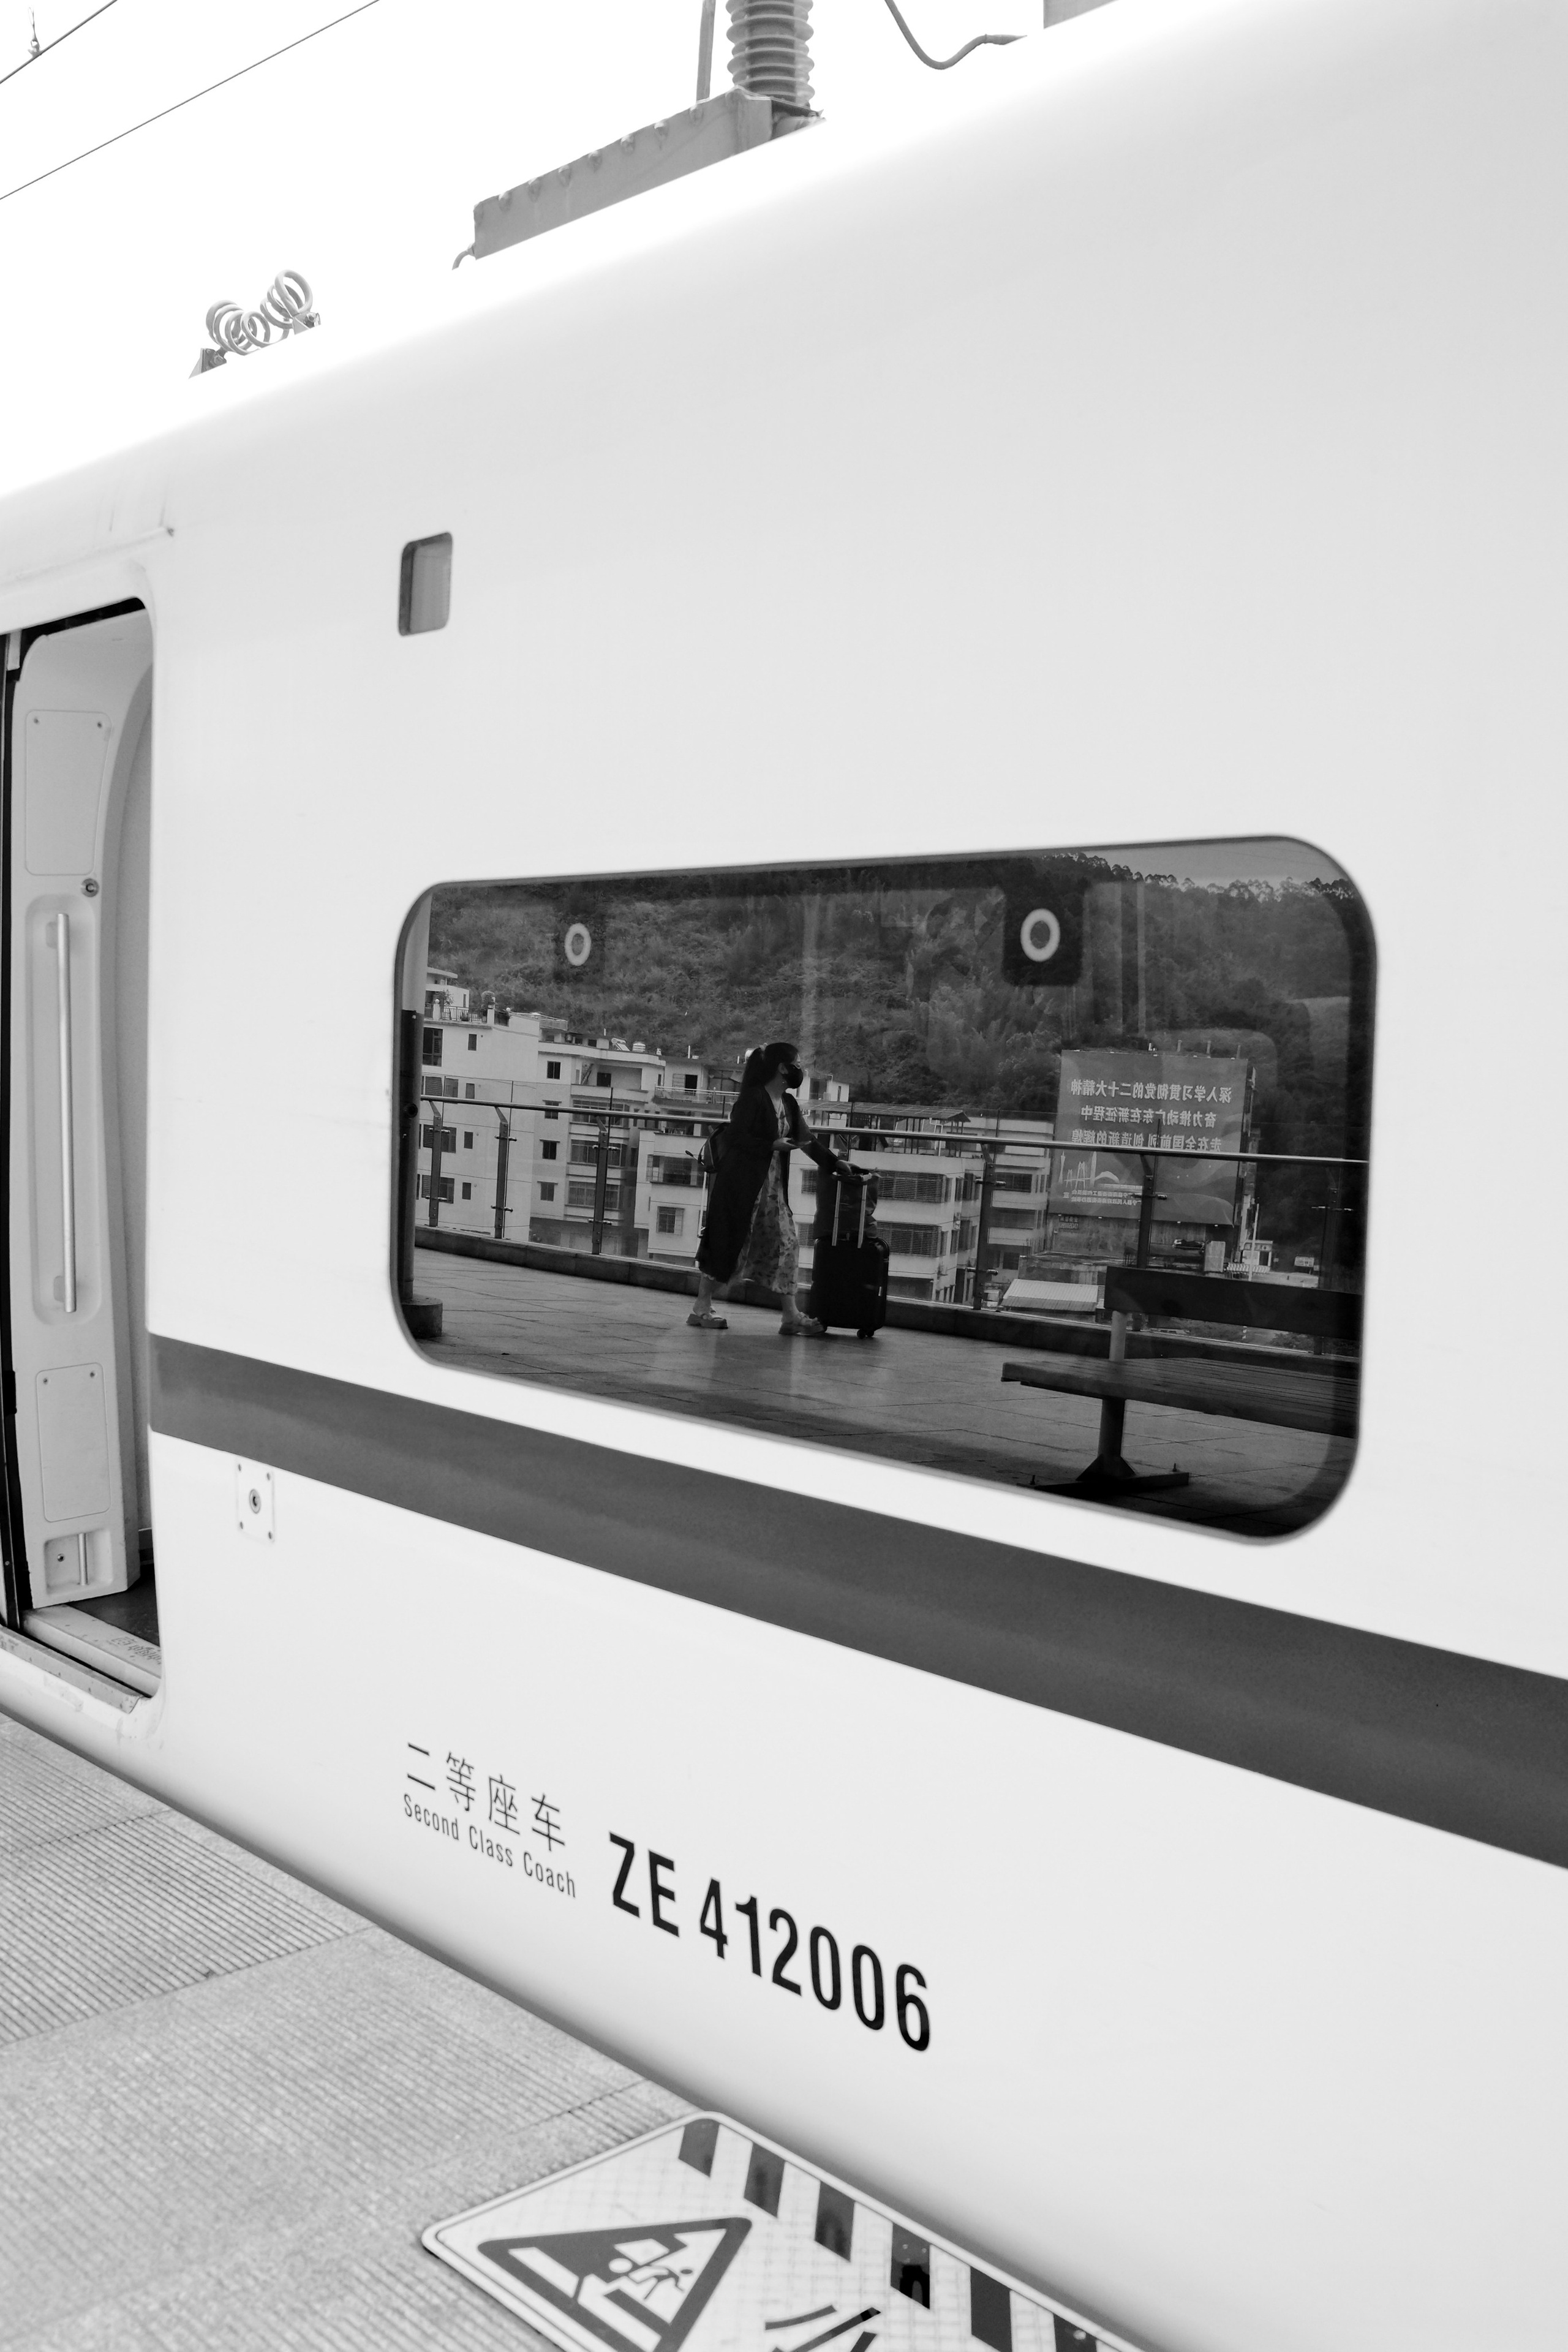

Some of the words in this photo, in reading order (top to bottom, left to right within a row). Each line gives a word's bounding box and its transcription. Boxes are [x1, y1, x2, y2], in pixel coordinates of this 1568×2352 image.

[404, 1793, 459, 1841] Second
[469, 1825, 513, 1868] Class
[523, 1851, 576, 1898] Coach
[407, 1742, 565, 1852] 二等座车
[609, 1831, 680, 1938] ZE
[699, 1877, 931, 2052] 412006
